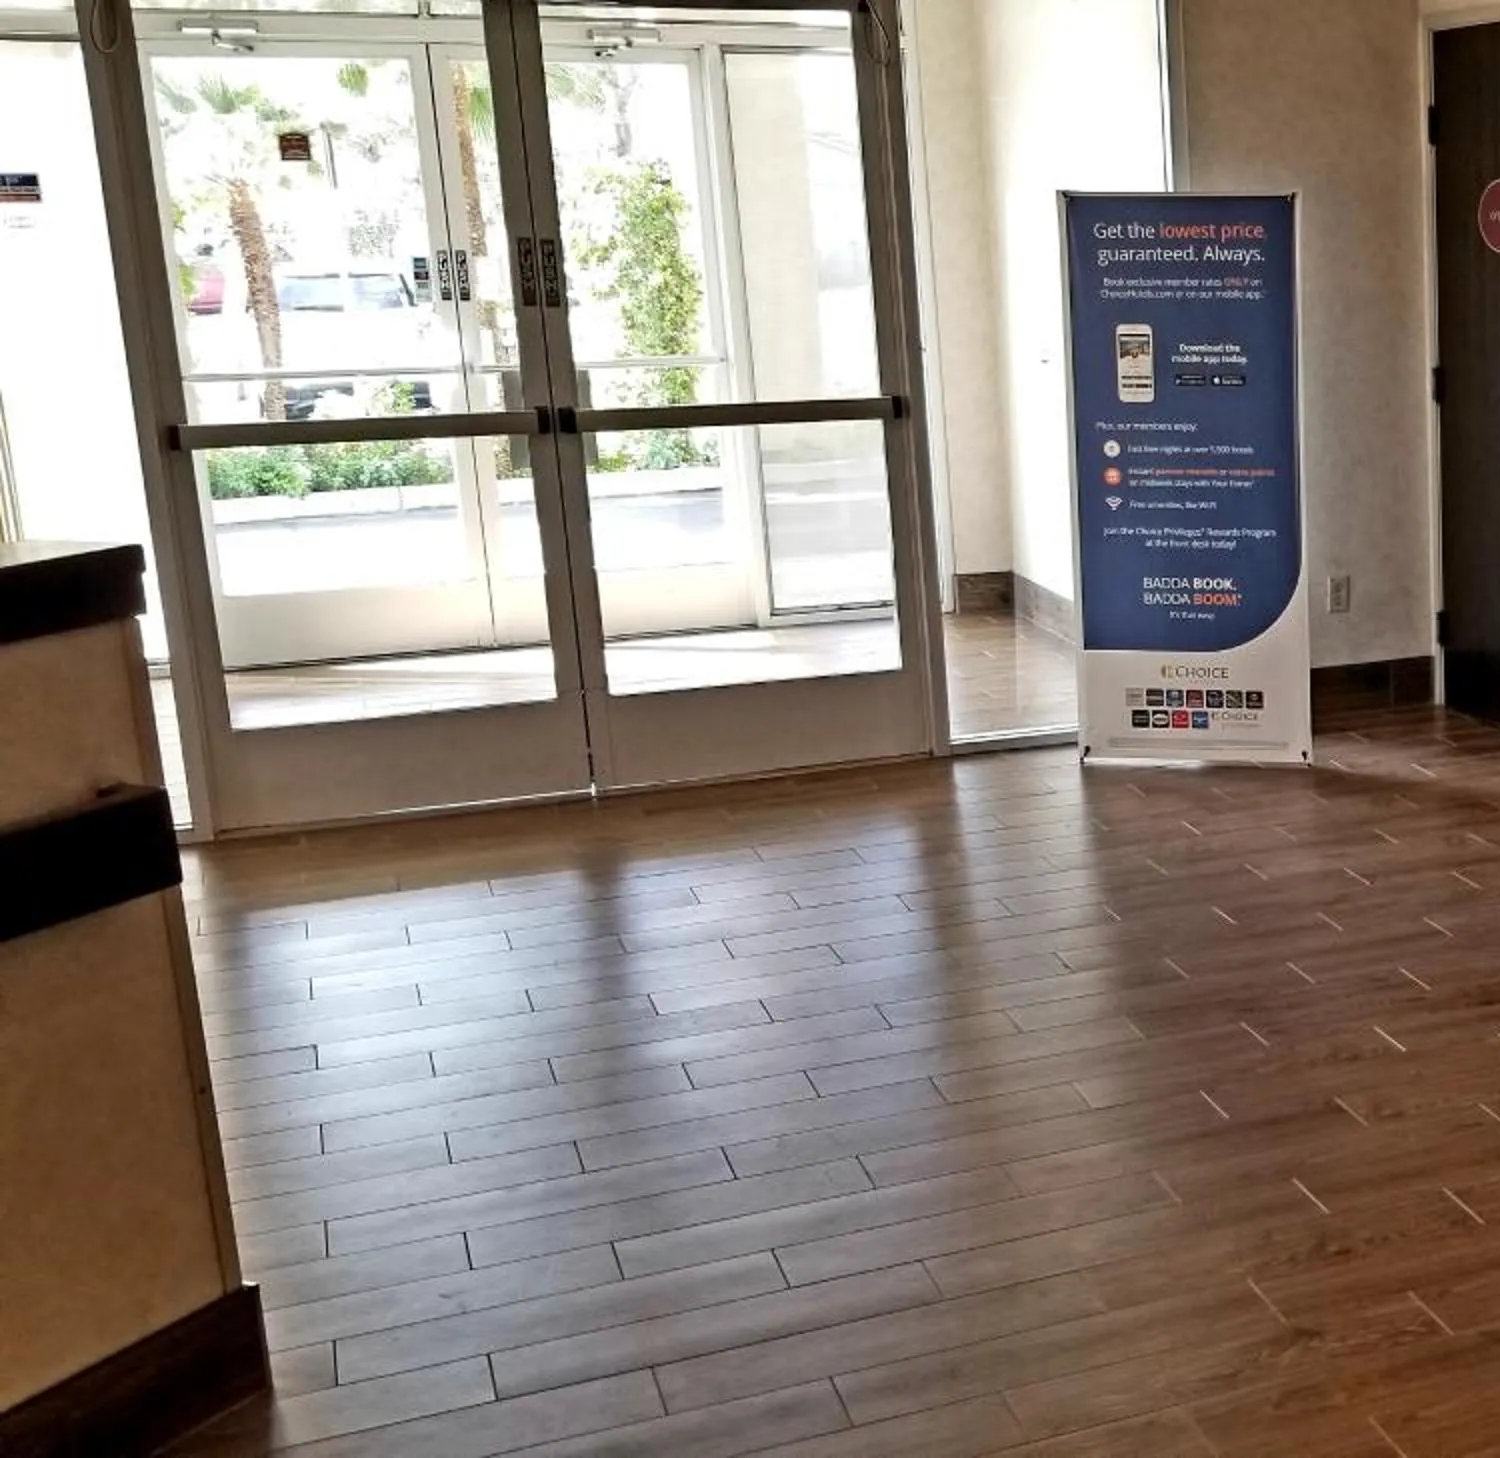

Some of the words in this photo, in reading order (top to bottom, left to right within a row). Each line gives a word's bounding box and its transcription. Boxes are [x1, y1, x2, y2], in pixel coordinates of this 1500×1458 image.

[1093, 222, 1126, 239] Get
[1128, 221, 1155, 239] the
[1159, 222, 1216, 239] lowest
[1097, 245, 1199, 267] guaranteed.
[1203, 245, 1265, 267] Always.
[1143, 577, 1190, 590] BADDA
[1143, 593, 1190, 606] BADDA
[1175, 665, 1229, 679] CHOICE
